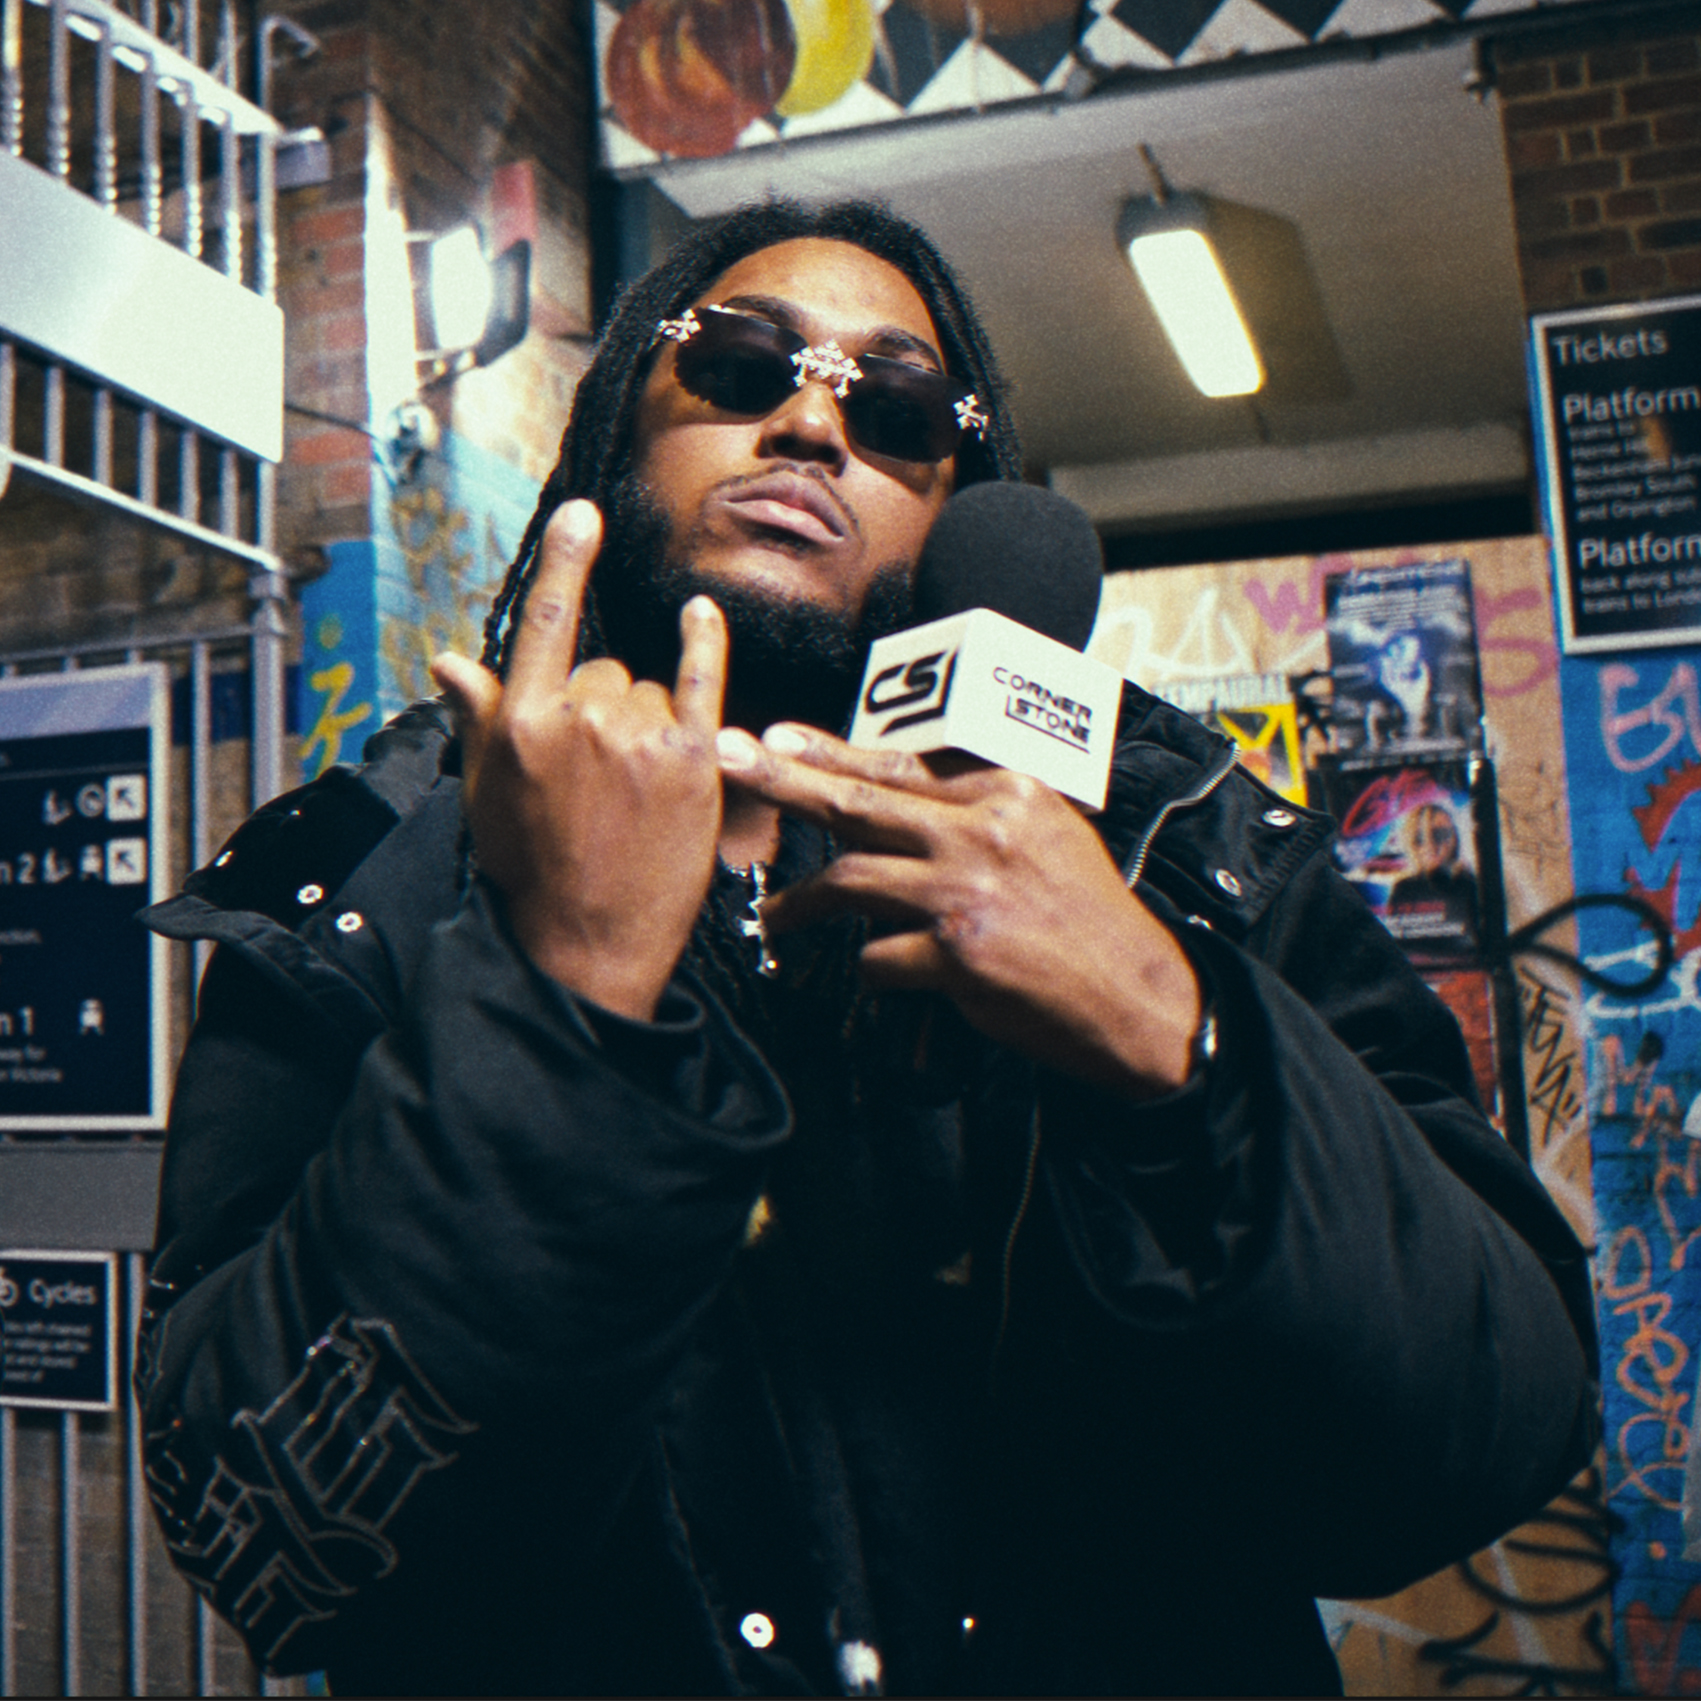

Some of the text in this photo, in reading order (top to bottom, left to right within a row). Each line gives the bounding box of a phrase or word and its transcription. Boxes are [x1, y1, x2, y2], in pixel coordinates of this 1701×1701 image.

[1552, 329, 1668, 365] Tickets
[1563, 386, 1701, 425] Platform
[993, 666, 1093, 726] CORNER
[1015, 697, 1091, 744] STONE
[18, 852, 37, 884] 2
[19, 1006, 34, 1035] 1
[28, 1278, 98, 1309] Cycles
